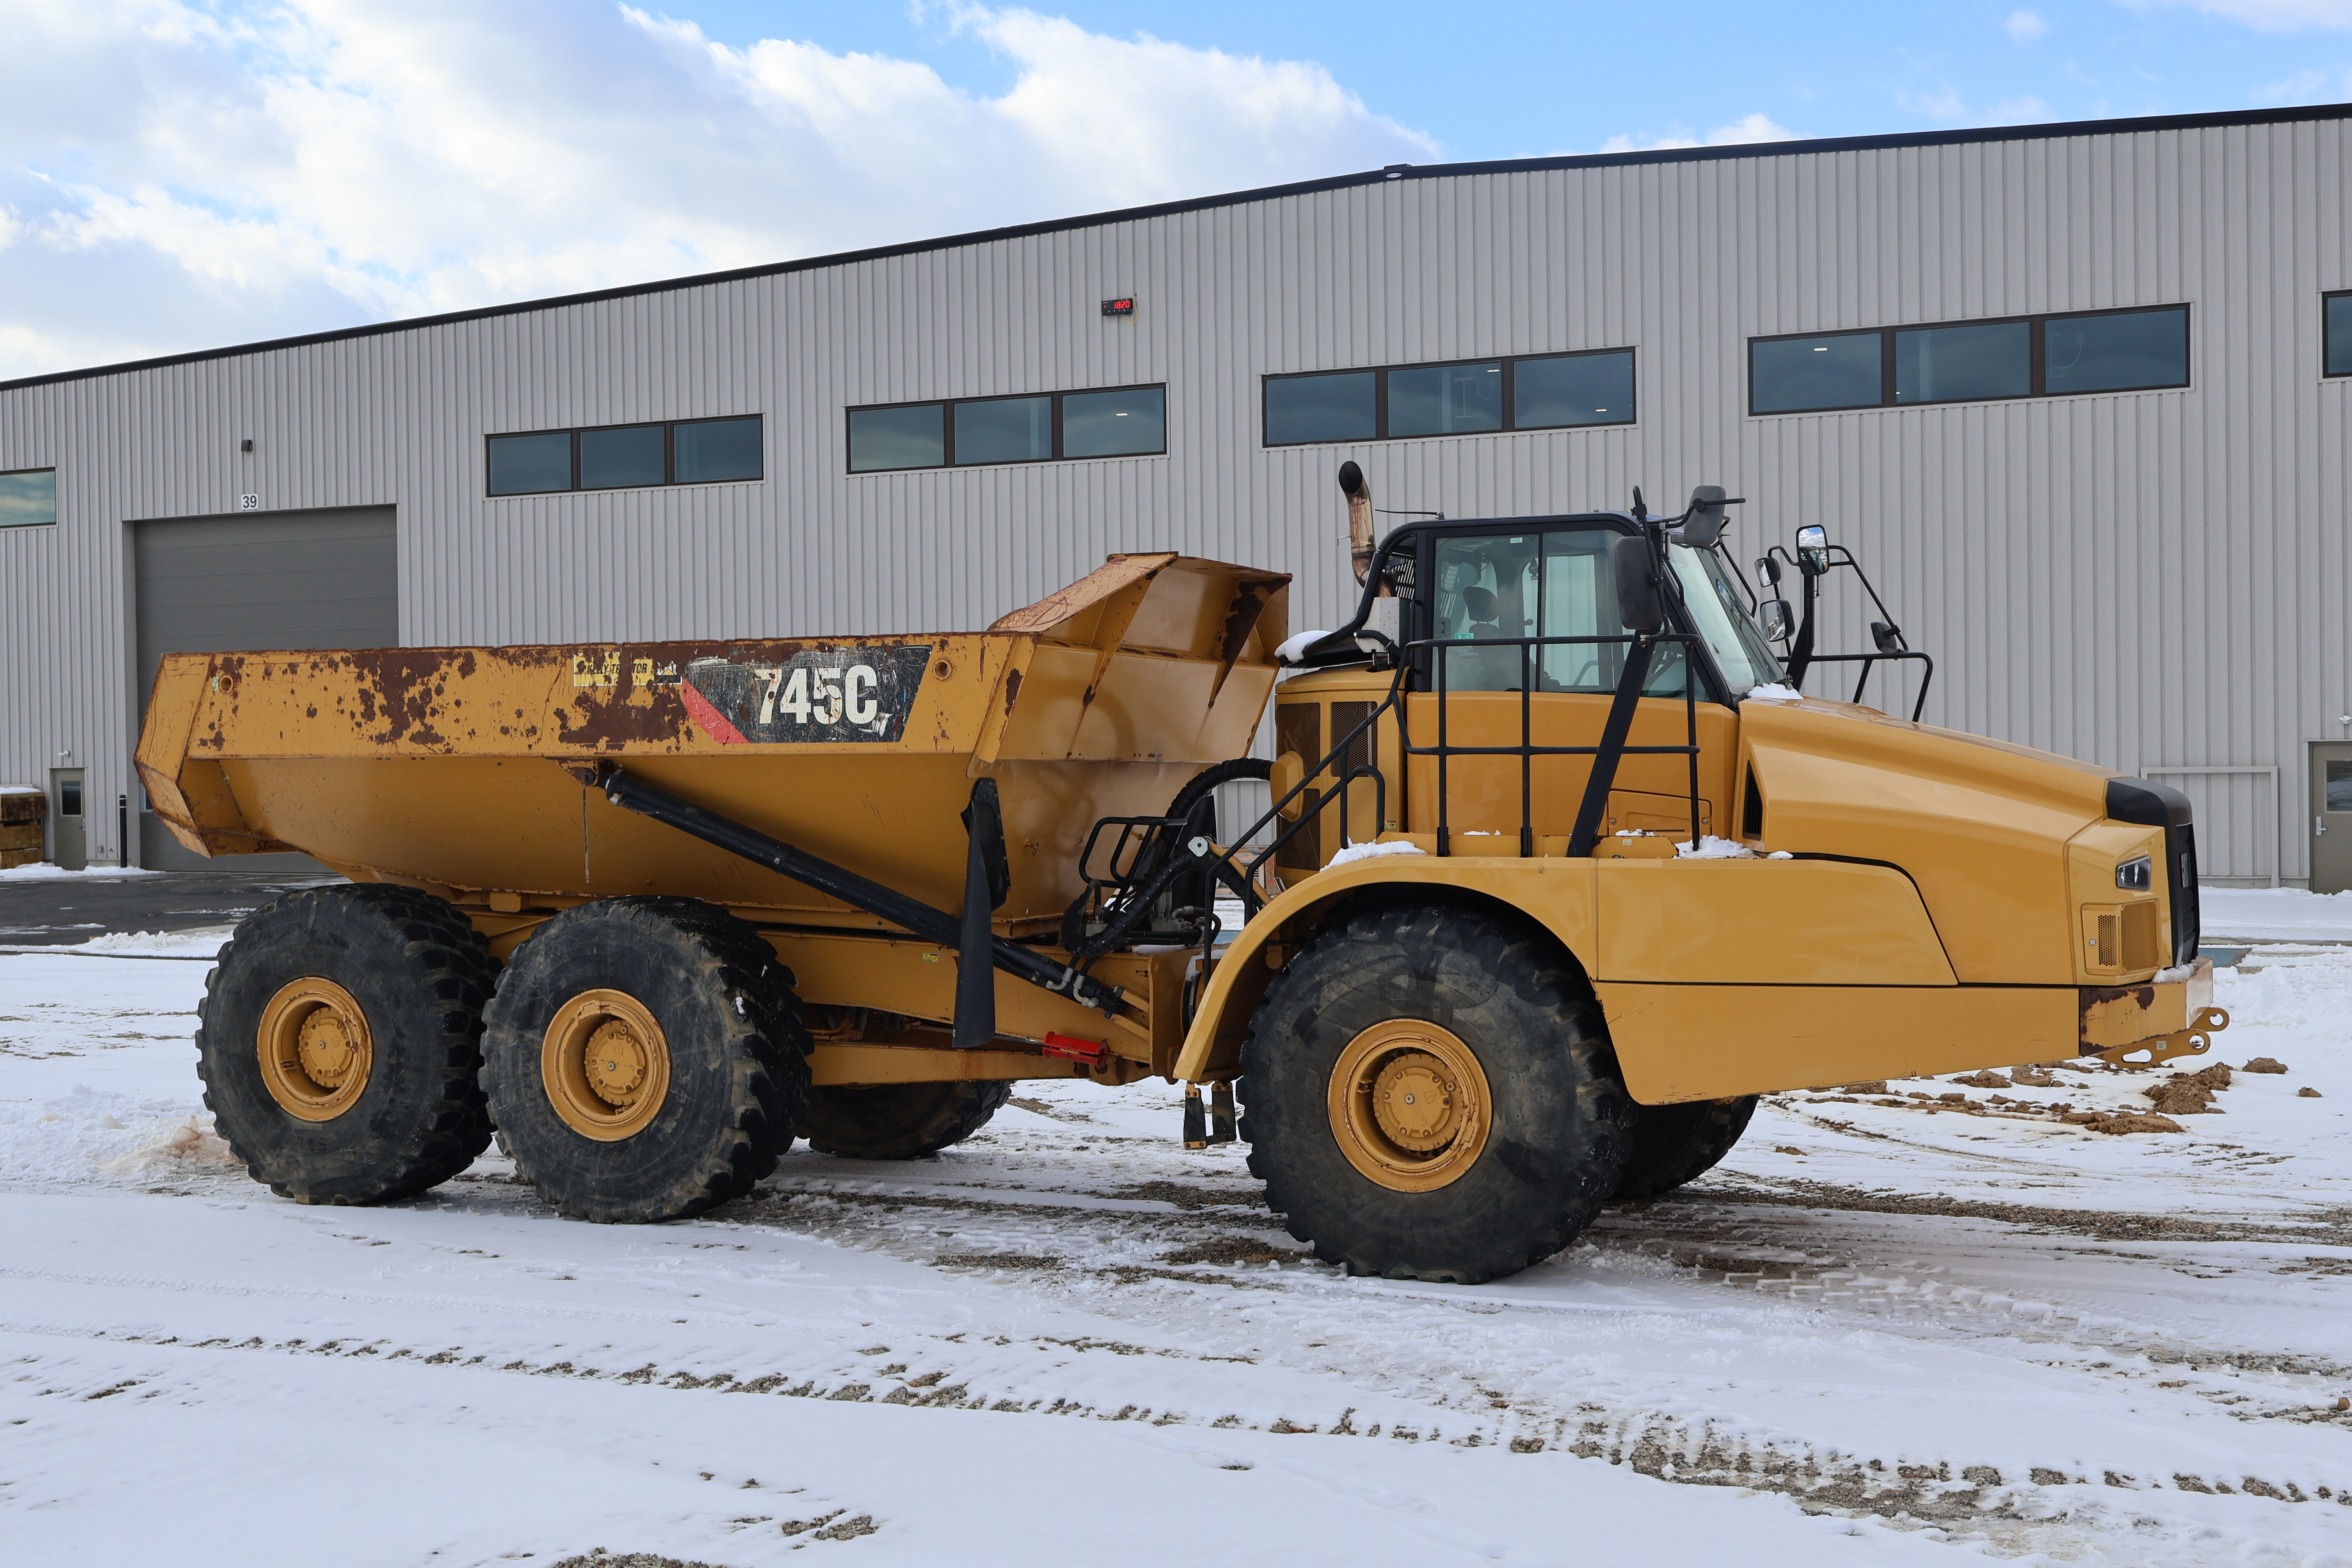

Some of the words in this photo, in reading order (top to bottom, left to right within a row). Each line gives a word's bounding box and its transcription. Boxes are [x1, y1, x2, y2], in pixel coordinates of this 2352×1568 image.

[1114, 301, 1130, 309] 1820
[243, 495, 257, 508] 39
[612, 663, 648, 674] TRTOR
[753, 665, 877, 724] 745C
